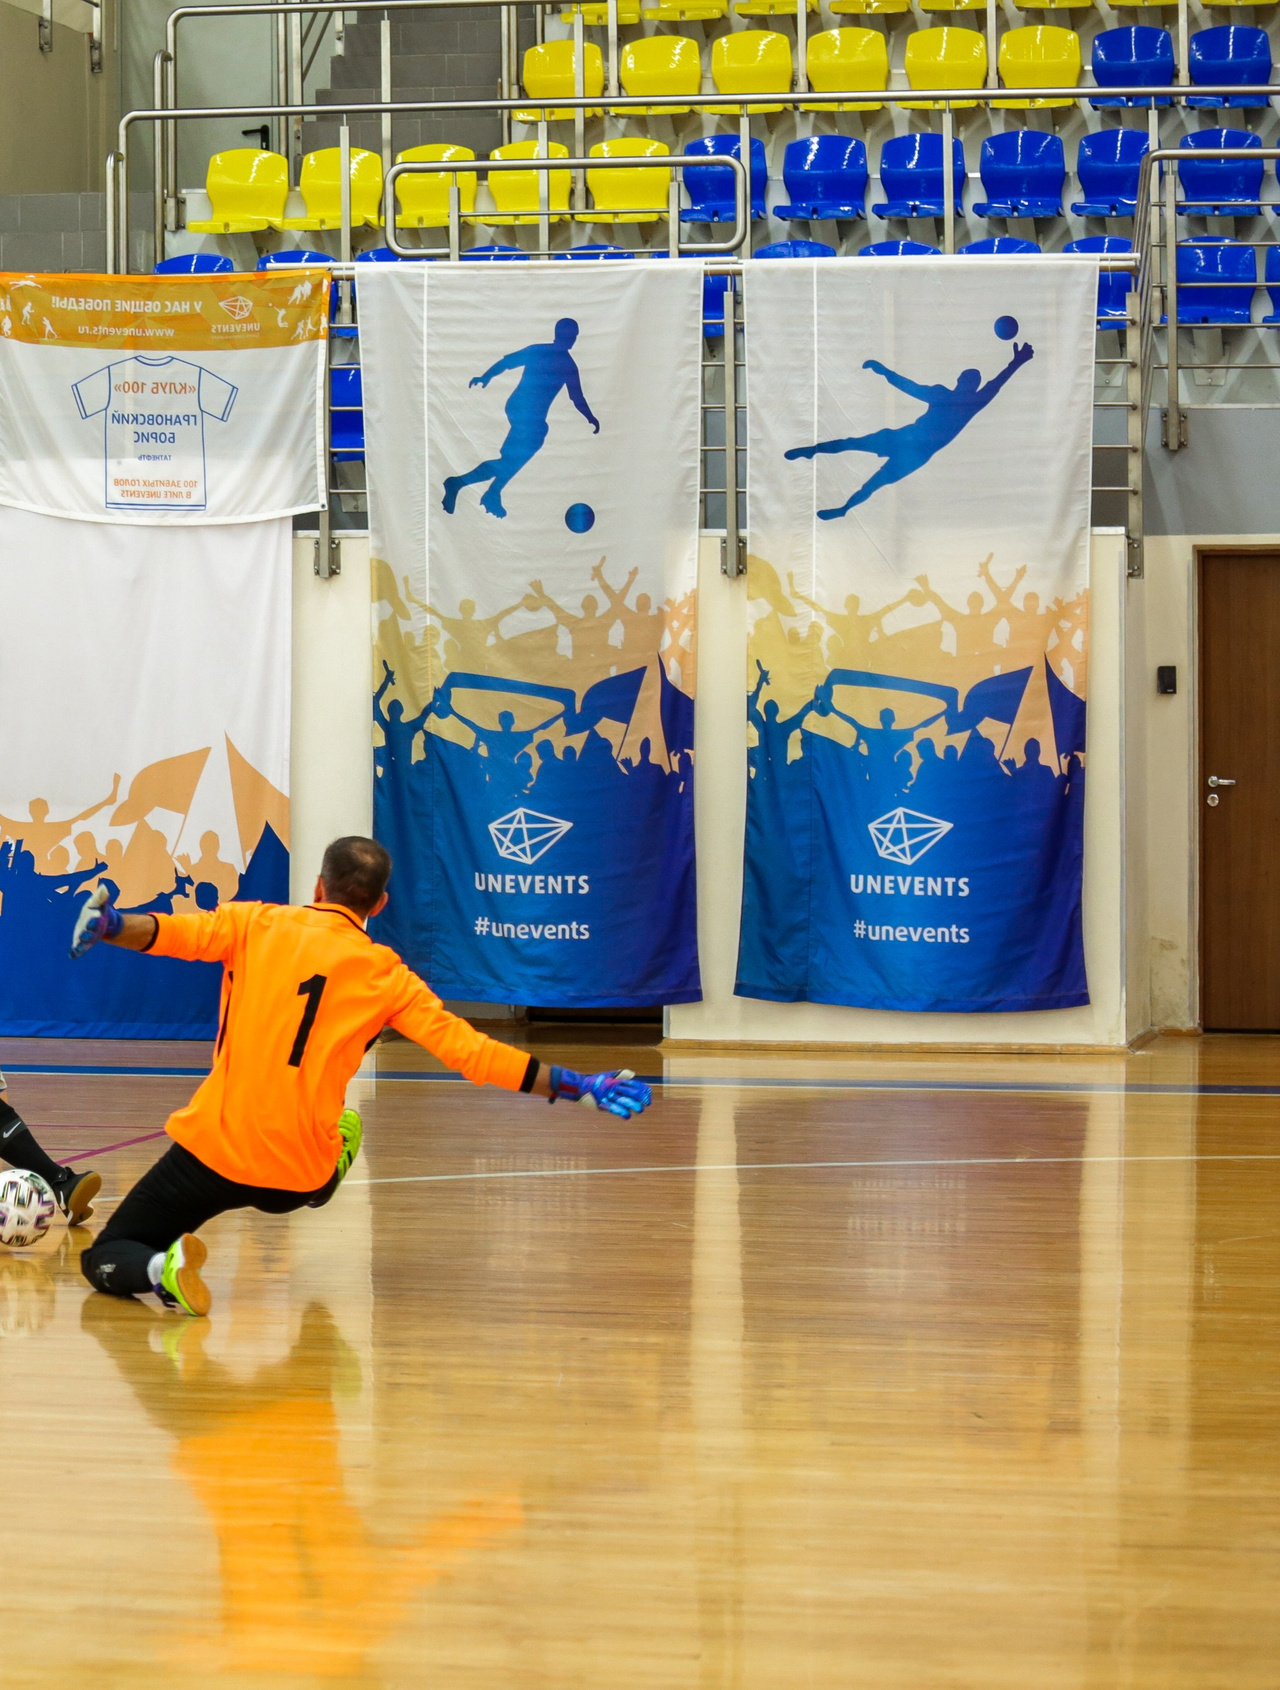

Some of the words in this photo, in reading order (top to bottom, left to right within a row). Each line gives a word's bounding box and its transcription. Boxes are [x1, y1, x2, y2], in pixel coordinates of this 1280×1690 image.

[474, 872, 590, 895] UNEVENTS
[850, 874, 970, 897] UNEVENTS
[474, 916, 590, 940] #unevents
[853, 919, 970, 944] #unevents
[287, 973, 328, 1068] 1
